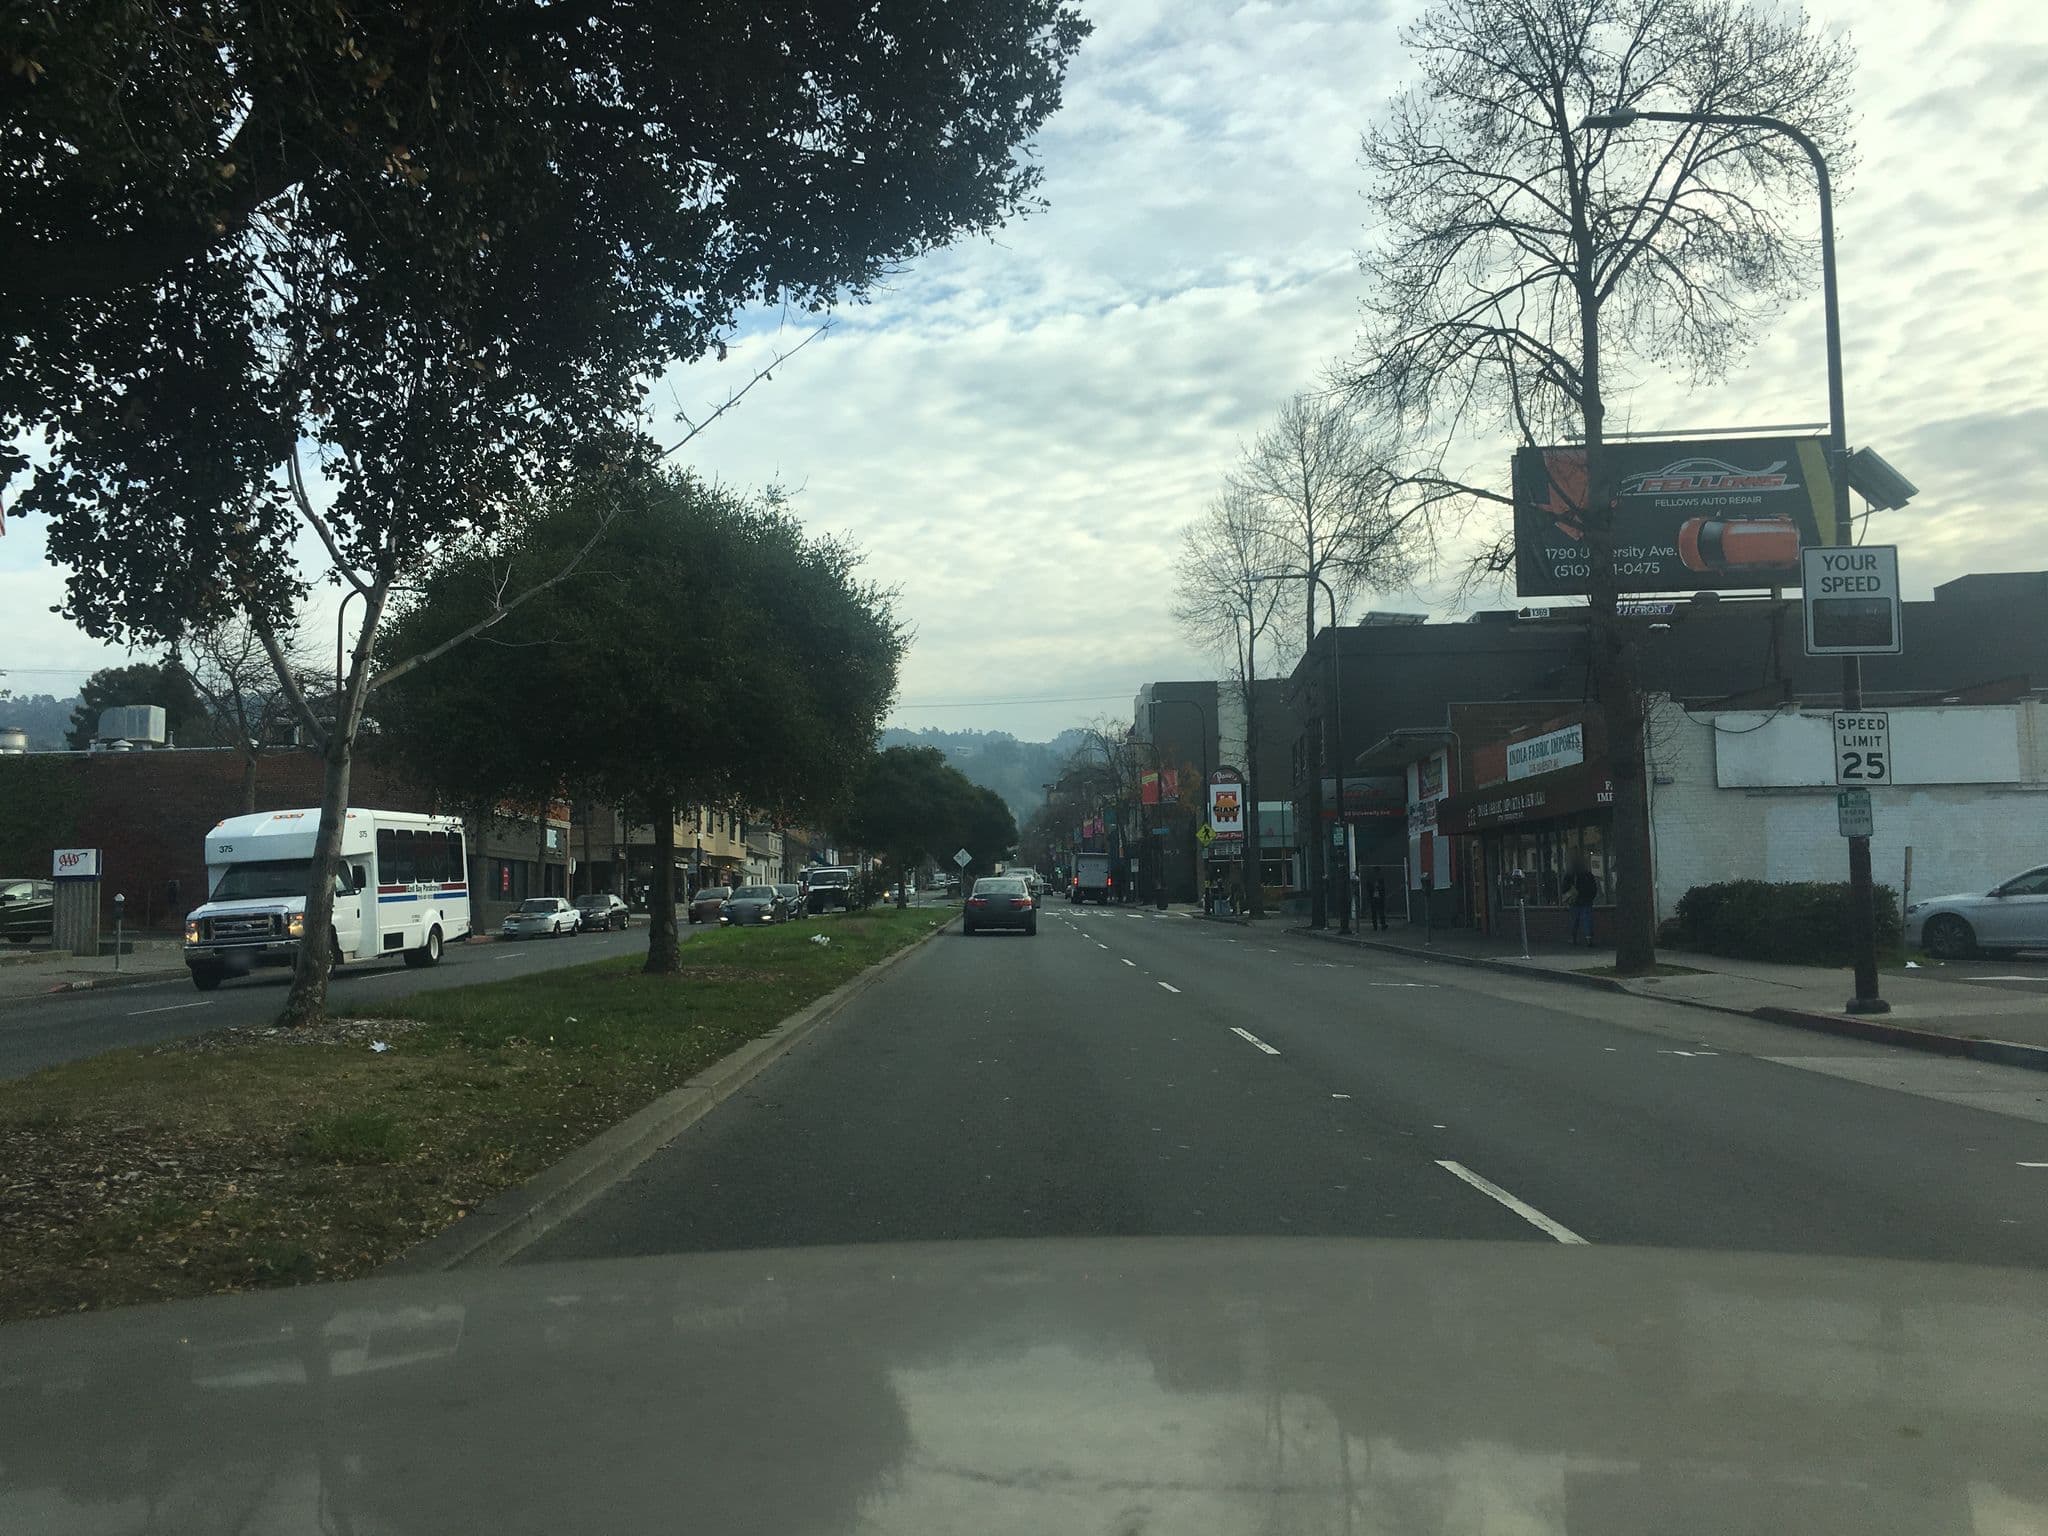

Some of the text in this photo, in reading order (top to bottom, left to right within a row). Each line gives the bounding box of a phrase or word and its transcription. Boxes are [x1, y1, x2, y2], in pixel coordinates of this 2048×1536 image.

[1655, 495, 1762, 507] FELLOWS AUTO REPAIR
[1545, 548, 1577, 560] 1790
[1649, 545, 1678, 557] Ave.
[1822, 554, 1877, 571] YOUR
[1554, 564, 1591, 577] (510)
[1821, 575, 1880, 593] SPEED
[1837, 719, 1885, 730] SPEED
[1843, 735, 1881, 747] LIMIT
[1842, 752, 1885, 779] 25
[218, 844, 234, 854] 375
